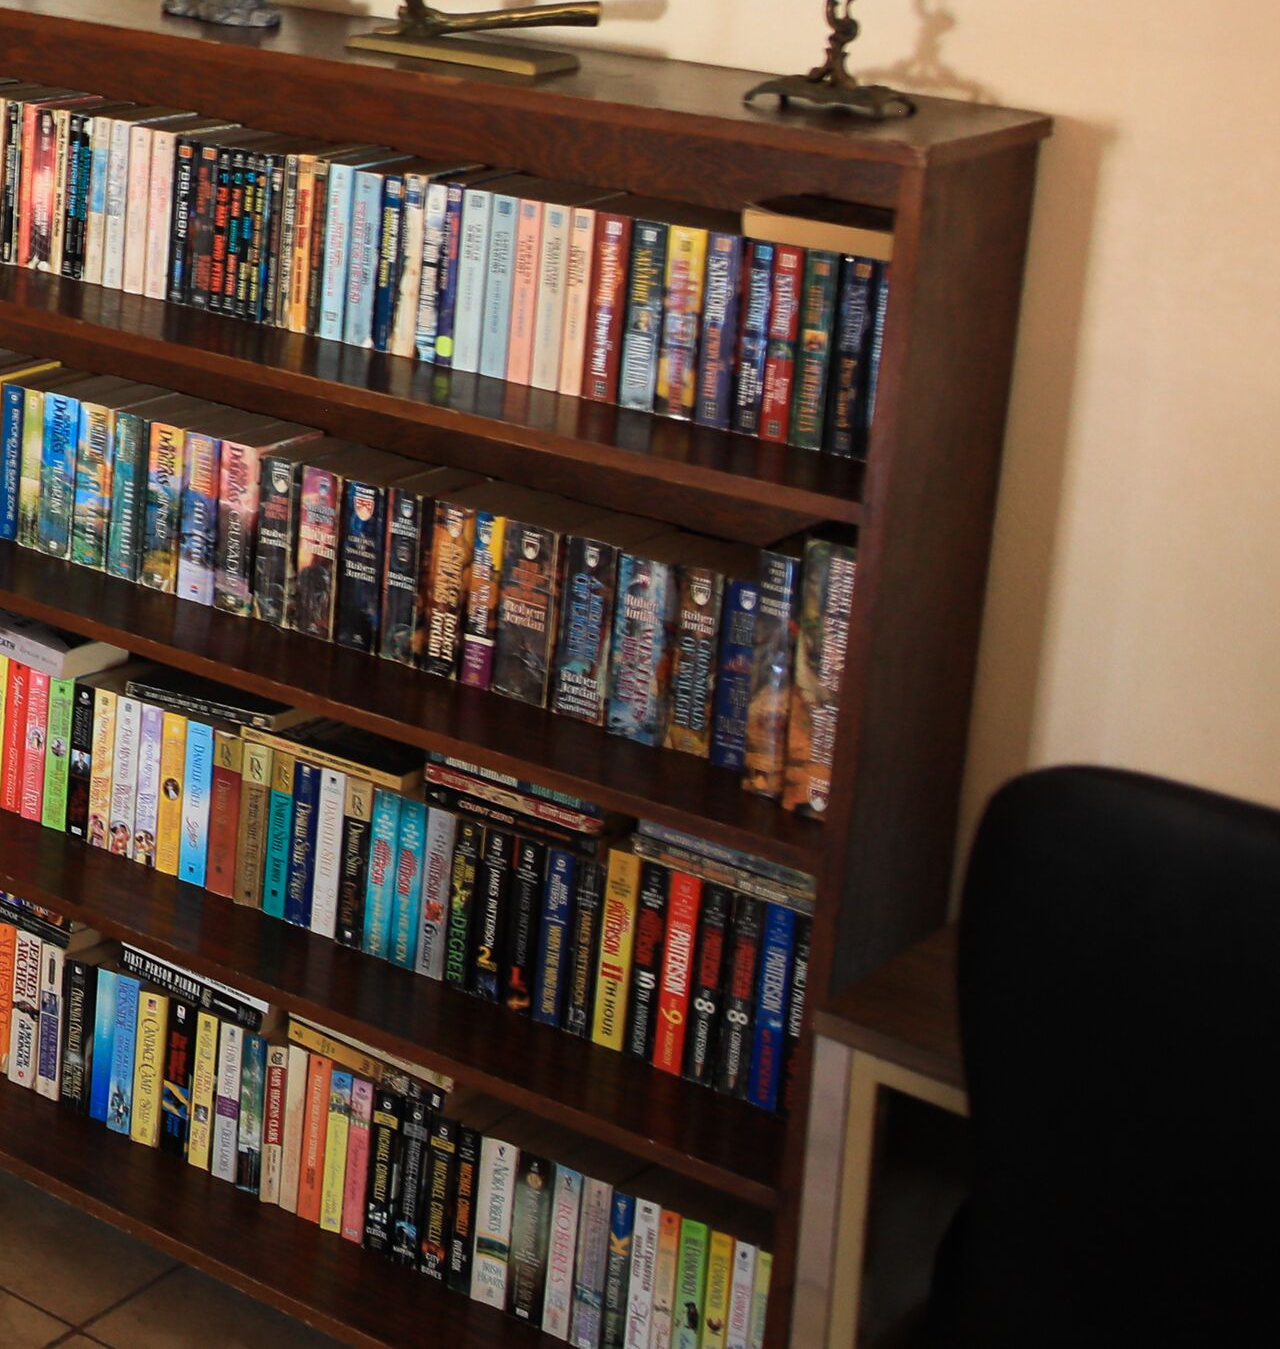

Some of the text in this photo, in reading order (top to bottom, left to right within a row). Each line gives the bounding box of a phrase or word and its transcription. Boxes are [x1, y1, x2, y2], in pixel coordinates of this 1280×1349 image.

[177, 165, 190, 237] FOOL MOON
[390, 207, 399, 235] LARRY
[211, 234, 226, 292] DAVID PETERS
[379, 259, 389, 287] SERIES
[6, 408, 19, 521] BEYOND THE SAFE ZONE
[225, 509, 240, 587] CRUSADER
[568, 573, 590, 655] OF LIGHT
[591, 577, 604, 588] A
[427, 608, 444, 657] Jordan
[441, 611, 457, 662] Robert
[819, 557, 842, 689] BRANDON SANDERSON
[835, 562, 856, 671] ROBERT JORDAN
[634, 628, 655, 722] WINTER'S
[675, 636, 694, 729] OF TWILIGHT
[692, 639, 712, 731] CROSSROADS
[6, 772, 15, 806] KINSELLA
[190, 743, 204, 809] DANIELLE STEEL
[320, 799, 338, 878] DANIELLE STEEL
[458, 800, 515, 825] COUNT ZERO
[485, 869, 501, 948] JAMES PATTERSON
[517, 883, 531, 966] JAMES PATTERSON
[548, 873, 560, 911] PATTERSON
[15, 938, 29, 997] ARCHER
[396, 914, 409, 962] HEAVEN
[446, 916, 468, 983] DEGREE
[541, 925, 561, 1015] WHEN THE WIND BLOWS
[573, 910, 591, 1007] JAMES PATTERSON
[602, 899, 623, 1037] PATTERSON HOUR
[664, 928, 691, 998] PATTERSON
[26, 940, 39, 1004] JEFFREY
[123, 950, 201, 997] FIRST PERSON PLURAL
[761, 950, 787, 1014] PATTERSON
[16, 1019, 26, 1069] OF HONOUR
[23, 1032, 32, 1069] MATTER
[68, 987, 84, 1052] AMANDA ASHLEY
[633, 1002, 647, 1056] ANNIVERSARY
[694, 1019, 708, 1065] CONFESSION
[61, 1060, 73, 1098] THE NIGHT
[72, 1065, 83, 1099] EMBRACE
[138, 1018, 160, 1095] CANDACE CAMP
[728, 1032, 742, 1076] CONFESSION
[268, 1068, 282, 1143] MARY HIGGINS CLARK
[374, 1127, 390, 1202] MICHAEL CONNELLY
[429, 1161, 447, 1247] MICHAEL CONNELLY
[452, 1162, 473, 1272] MICHAEL CONNELLY OVERLOOK
[488, 1164, 509, 1233] NORA ROBERTS
[551, 1201, 573, 1284] ROBERTS
[642, 1250, 654, 1291] EVANOVICH
[607, 1256, 624, 1309] NORA ROBERTS
